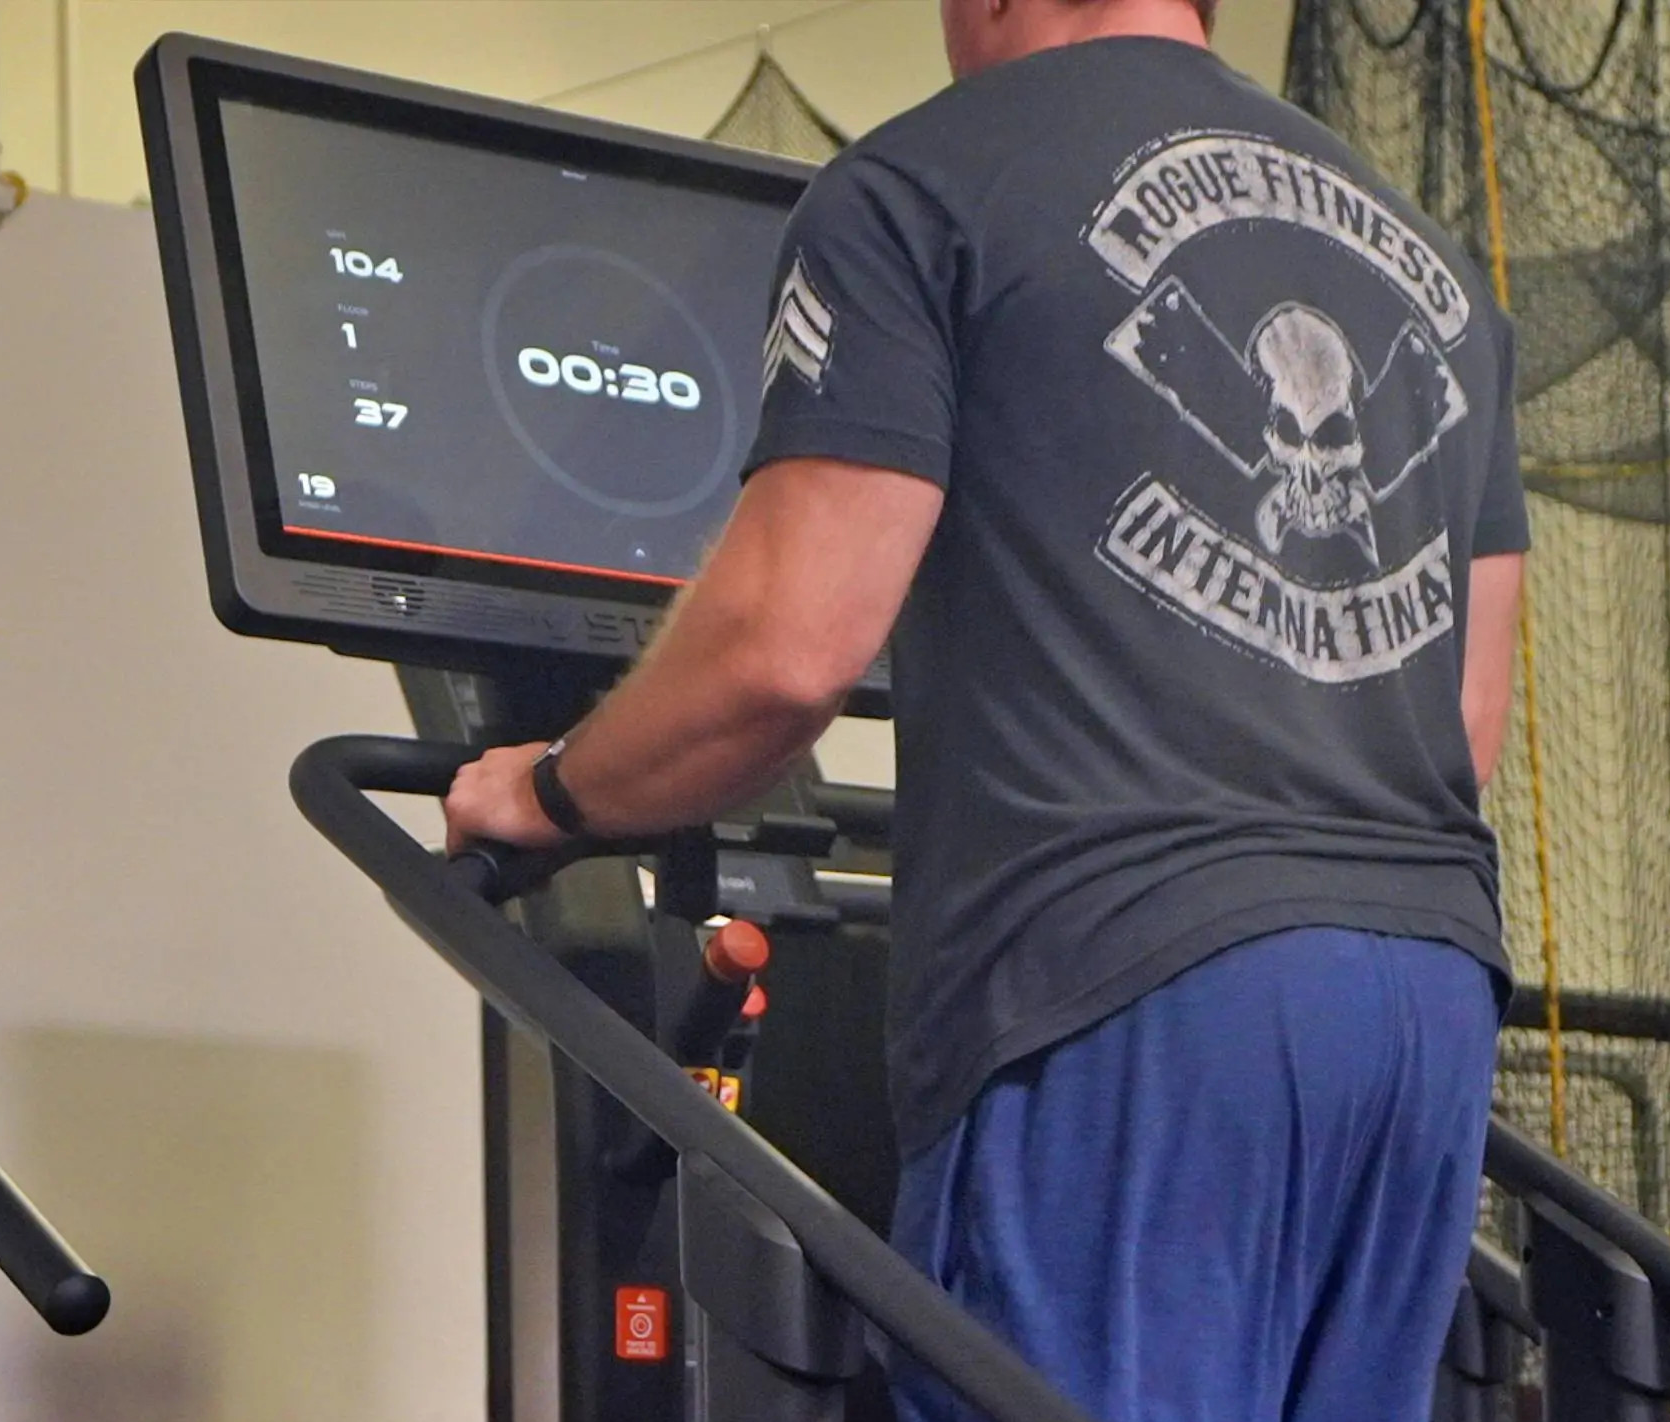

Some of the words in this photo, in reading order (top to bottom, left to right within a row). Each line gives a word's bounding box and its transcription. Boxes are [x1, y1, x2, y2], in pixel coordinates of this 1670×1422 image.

[1110, 151, 1251, 260] ROGUE
[1255, 154, 1459, 314] FITNESS
[329, 247, 403, 284] 104
[341, 322, 358, 349] 1
[518, 347, 701, 410] 00:30
[353, 397, 409, 430] 37
[297, 472, 336, 499] 19
